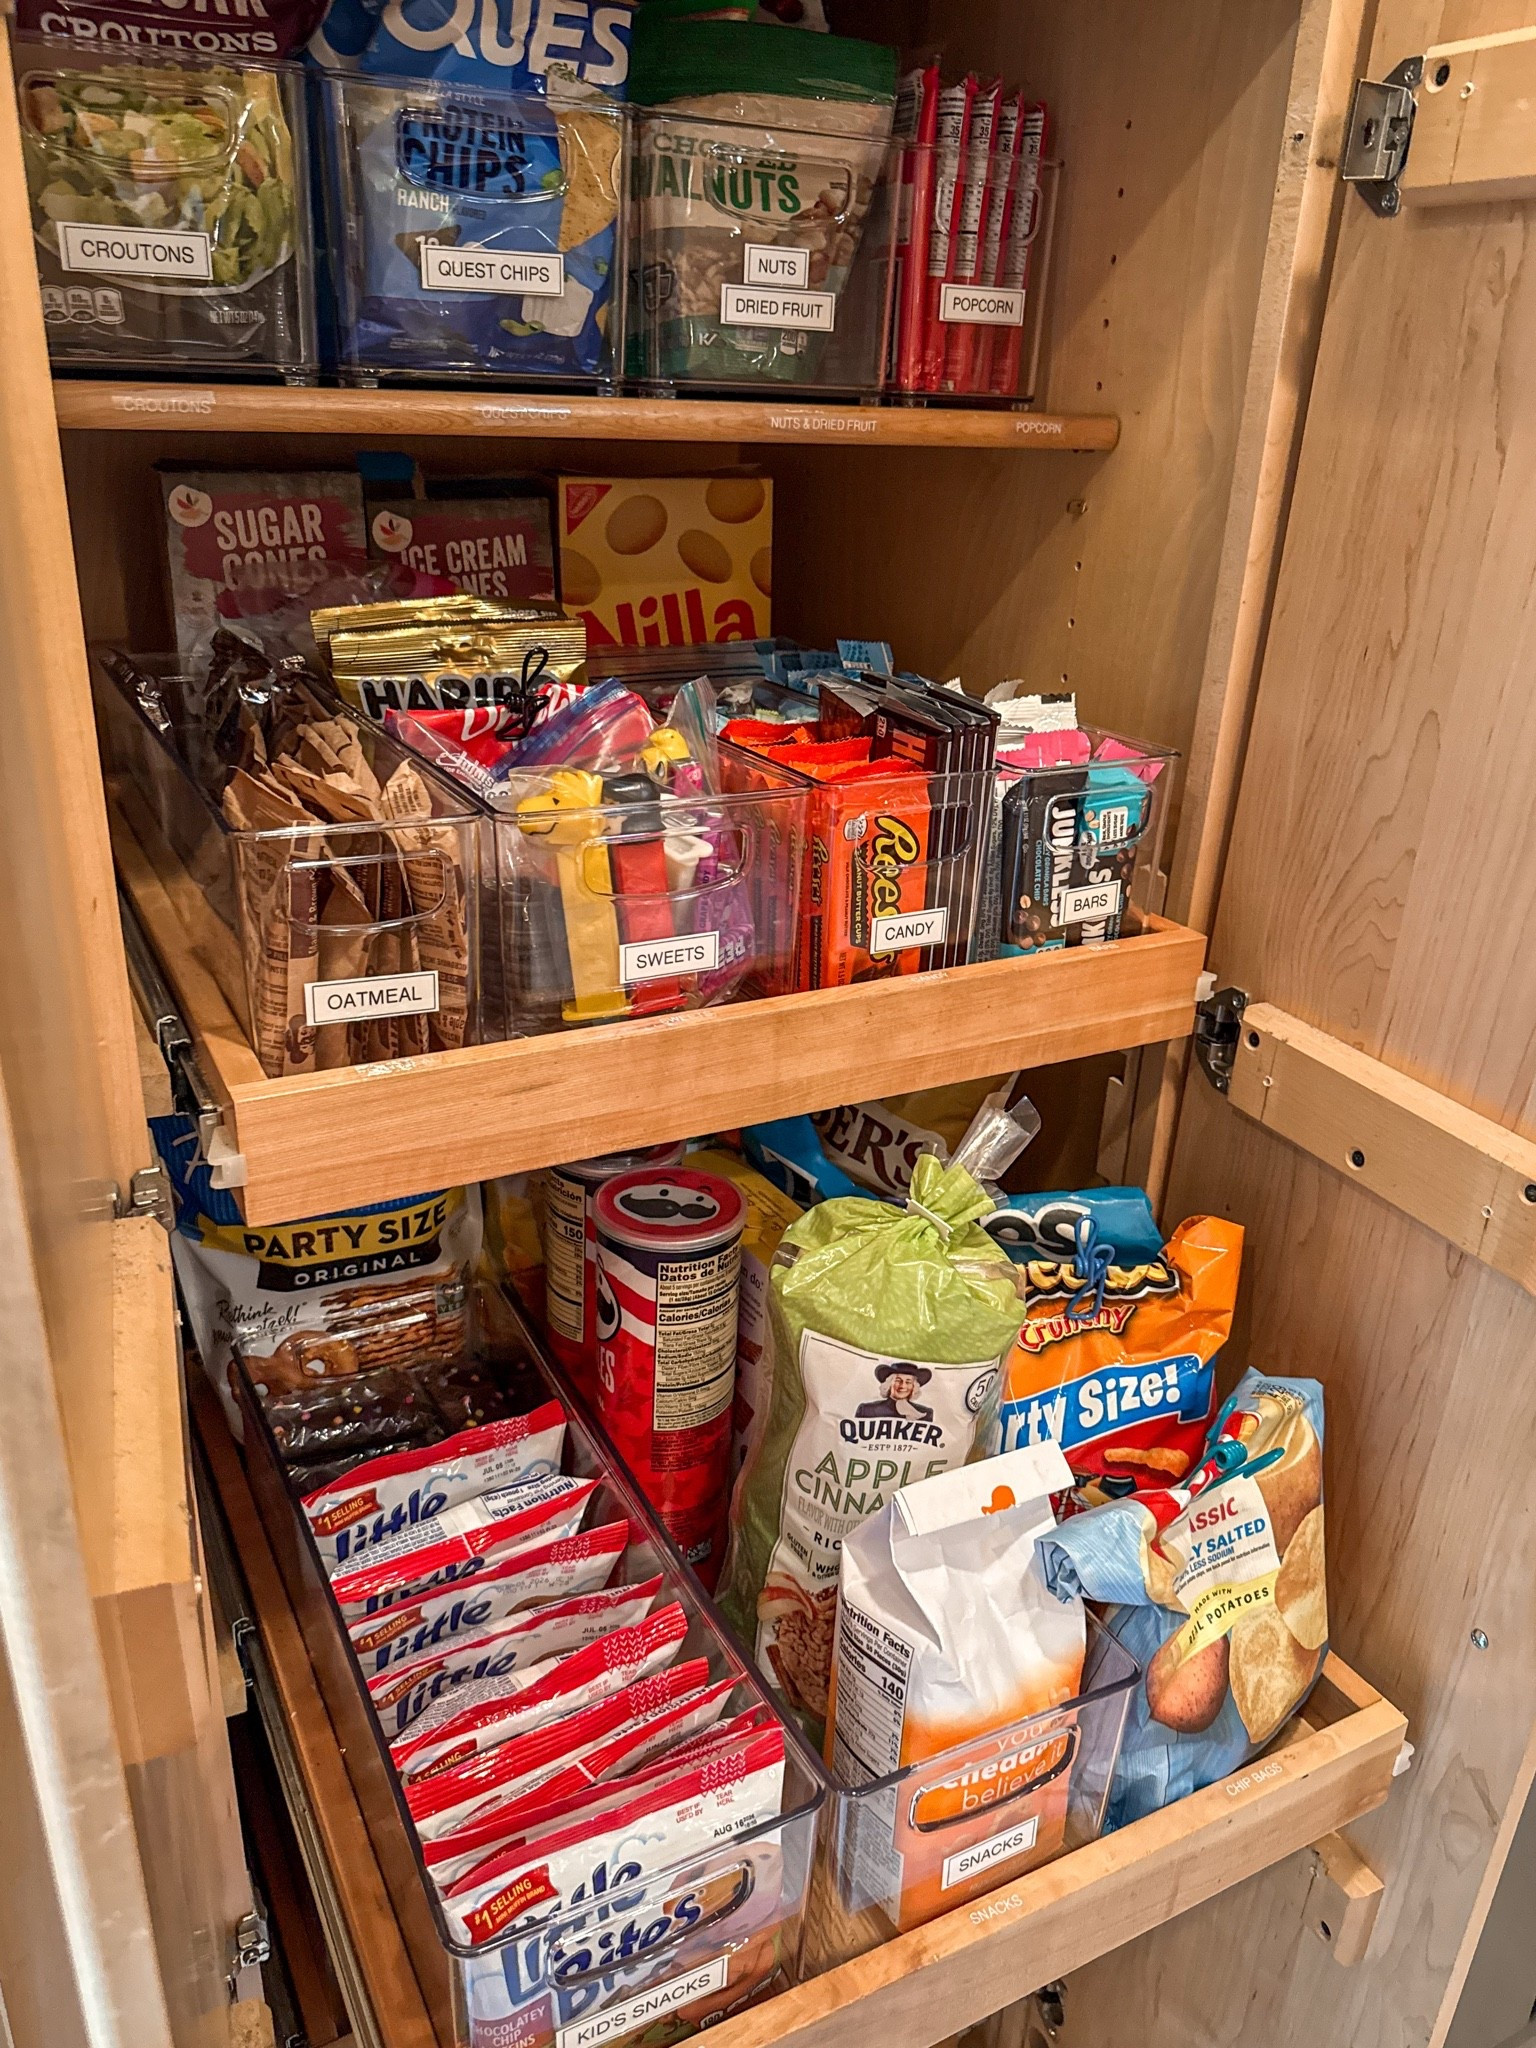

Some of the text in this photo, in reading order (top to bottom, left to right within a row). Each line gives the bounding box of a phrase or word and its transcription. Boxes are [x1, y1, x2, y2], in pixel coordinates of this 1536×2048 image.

[40, 12, 278, 52] CROUTONS
[403, 138, 529, 195] CHIPS
[397, 187, 450, 213] RANCH
[81, 238, 195, 264] CROUTONS
[438, 259, 550, 283] QUEST CHIPS
[758, 258, 797, 276] NUTS
[736, 298, 823, 319] DRIED FRUIT
[952, 297, 1014, 315] POPCORN
[122, 397, 212, 414] CROUTONS
[771, 416, 877, 432] NUTS & DRIED FRUIT
[1016, 421, 1062, 434] POPCORN
[214, 503, 325, 550] SUGAR
[445, 534, 528, 574] CREAM
[577, 587, 758, 647] Nilla
[1033, 838, 1043, 901] CHOCOLATE CHIP
[1074, 893, 1108, 912] BARS
[854, 890, 863, 944] BUTTER CUPS
[885, 920, 934, 941] CANDY
[636, 946, 704, 969] SWEETS
[328, 986, 422, 1010] OATMEAL
[243, 1199, 447, 1260] PARTY SIZE
[563, 1225, 583, 1240] 150
[293, 1251, 421, 1286] ORIGINAL
[659, 1259, 715, 1274] Nutrition
[659, 1268, 714, 1282] Datos de
[1018, 1304, 1136, 1352] Crunchy
[1077, 1363, 1181, 1429] Size!
[839, 1418, 944, 1448] QUAKER
[893, 1444, 914, 1452] 1877
[814, 1450, 949, 1490] APPLE
[331, 1496, 364, 1522] SELLING
[491, 1479, 575, 1518] Nutrition Facts
[798, 1495, 846, 1534] FLAVOR WITH
[814, 1530, 843, 1551] RIC
[1206, 1517, 1266, 1554] SALTED
[1189, 1545, 1235, 1573] LESS SODIUM
[1194, 1588, 1233, 1614] MADE WITH
[1205, 1587, 1270, 1625] POTATOES
[882, 1630, 911, 1659] Facts
[881, 1676, 904, 1700] 140
[962, 1741, 1064, 1812] believe it
[1225, 1761, 1283, 1798] CHIP BAGS
[715, 1789, 733, 1800] TEAR
[676, 1804, 694, 1816] BEST
[676, 1807, 704, 1824] USED BY
[713, 1823, 733, 1838] AUG
[734, 1818, 745, 1829] 16
[958, 1832, 1024, 1872] SNACKS
[474, 1877, 532, 1930] #1 SELLING
[969, 1894, 1023, 1926] SNACKS
[501, 1860, 647, 2006] Little
[553, 1892, 703, 2027] Bites
[577, 1973, 711, 2045] KID'S SNACKS
[492, 2028, 522, 2047] CHIP
